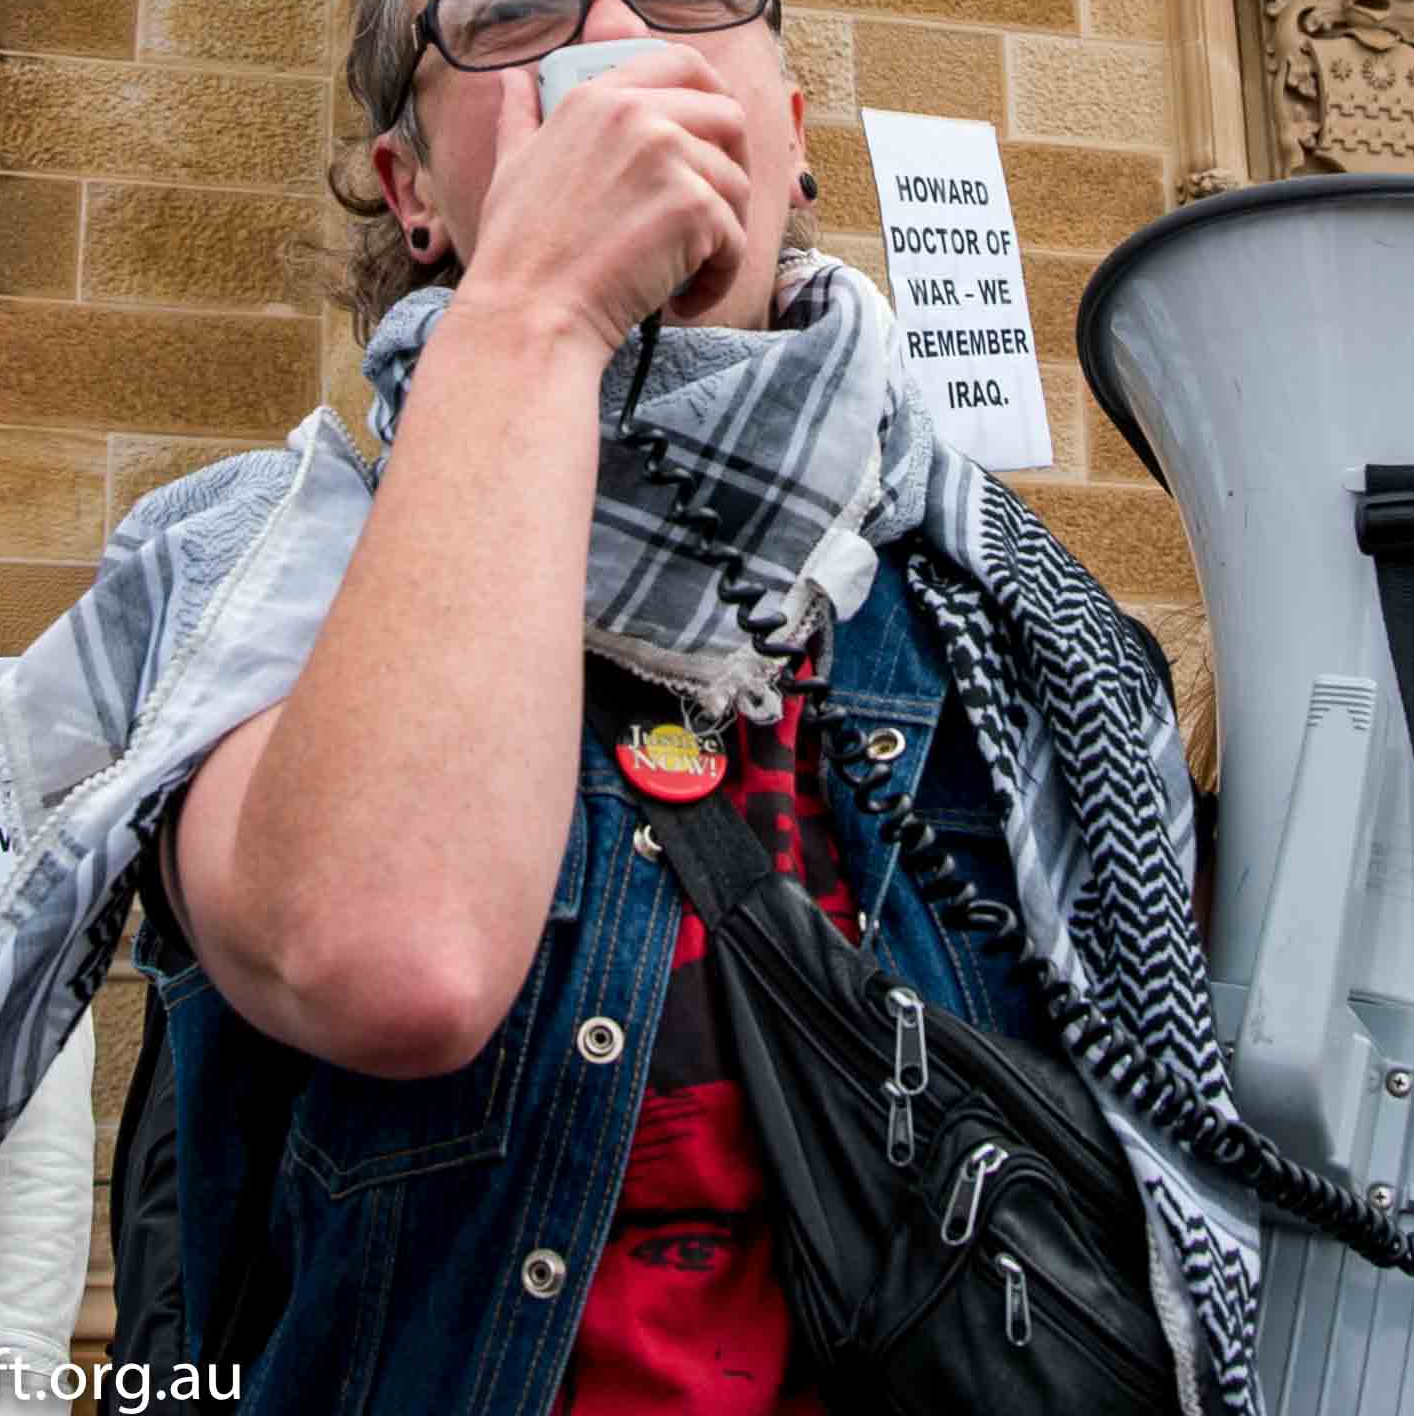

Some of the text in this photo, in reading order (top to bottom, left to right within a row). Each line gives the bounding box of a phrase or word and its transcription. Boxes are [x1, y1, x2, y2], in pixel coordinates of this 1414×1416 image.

[895, 174, 989, 206] HOWARD
[890, 225, 1012, 256] DOCTOR OF
[907, 278, 960, 306] WAR
[977, 279, 1012, 305] WE
[907, 328, 1030, 359] REMEMBER
[947, 379, 1010, 409] IRAQ.
